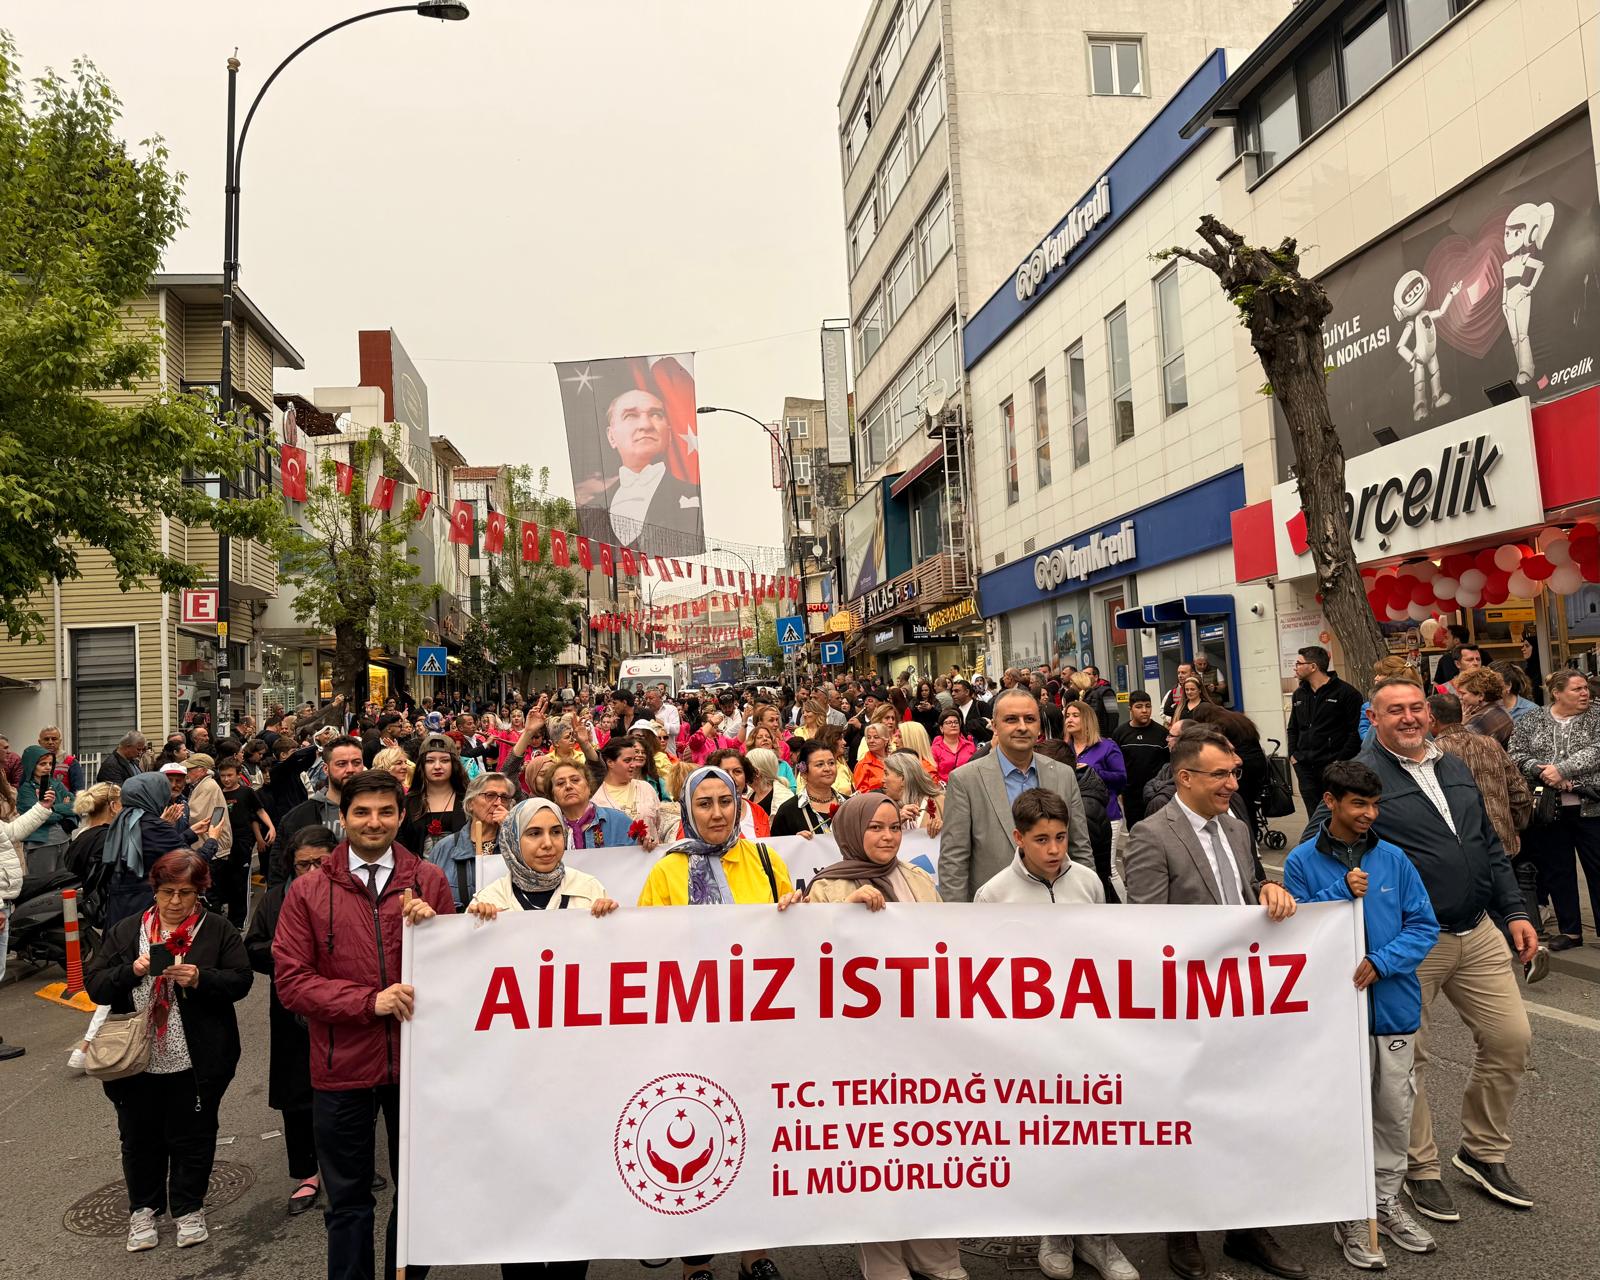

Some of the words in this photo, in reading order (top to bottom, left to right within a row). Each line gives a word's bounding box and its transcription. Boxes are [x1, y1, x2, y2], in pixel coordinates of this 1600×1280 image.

[1322, 314, 1361, 350] OJİYLE
[1336, 325, 1391, 368] NOKTASI
[825, 337, 839, 375] CEVAP
[1550, 356, 1594, 386] arçelik
[1062, 519, 1136, 581] YapıKredi
[192, 595, 210, 618] E
[807, 603, 828, 612] FOTO
[868, 584, 895, 618] ATLAS
[825, 644, 838, 662] P
[475, 949, 796, 1032] AİLEMİZ
[818, 941, 1309, 1021] İSTİKBALİMİZ
[771, 1080, 826, 1109] T.C.
[832, 1072, 987, 1107] TEKİRDAĞ
[993, 1073, 1123, 1105] VALİLİĞİ
[771, 1118, 839, 1153] AİLE
[845, 1121, 885, 1150] VE
[892, 1119, 1011, 1148] SOSYAL
[1019, 1114, 1193, 1147] HİZMETLER
[771, 1164, 799, 1197] İL
[806, 1156, 1011, 1195] MÜDÜRLÜĞÜ
